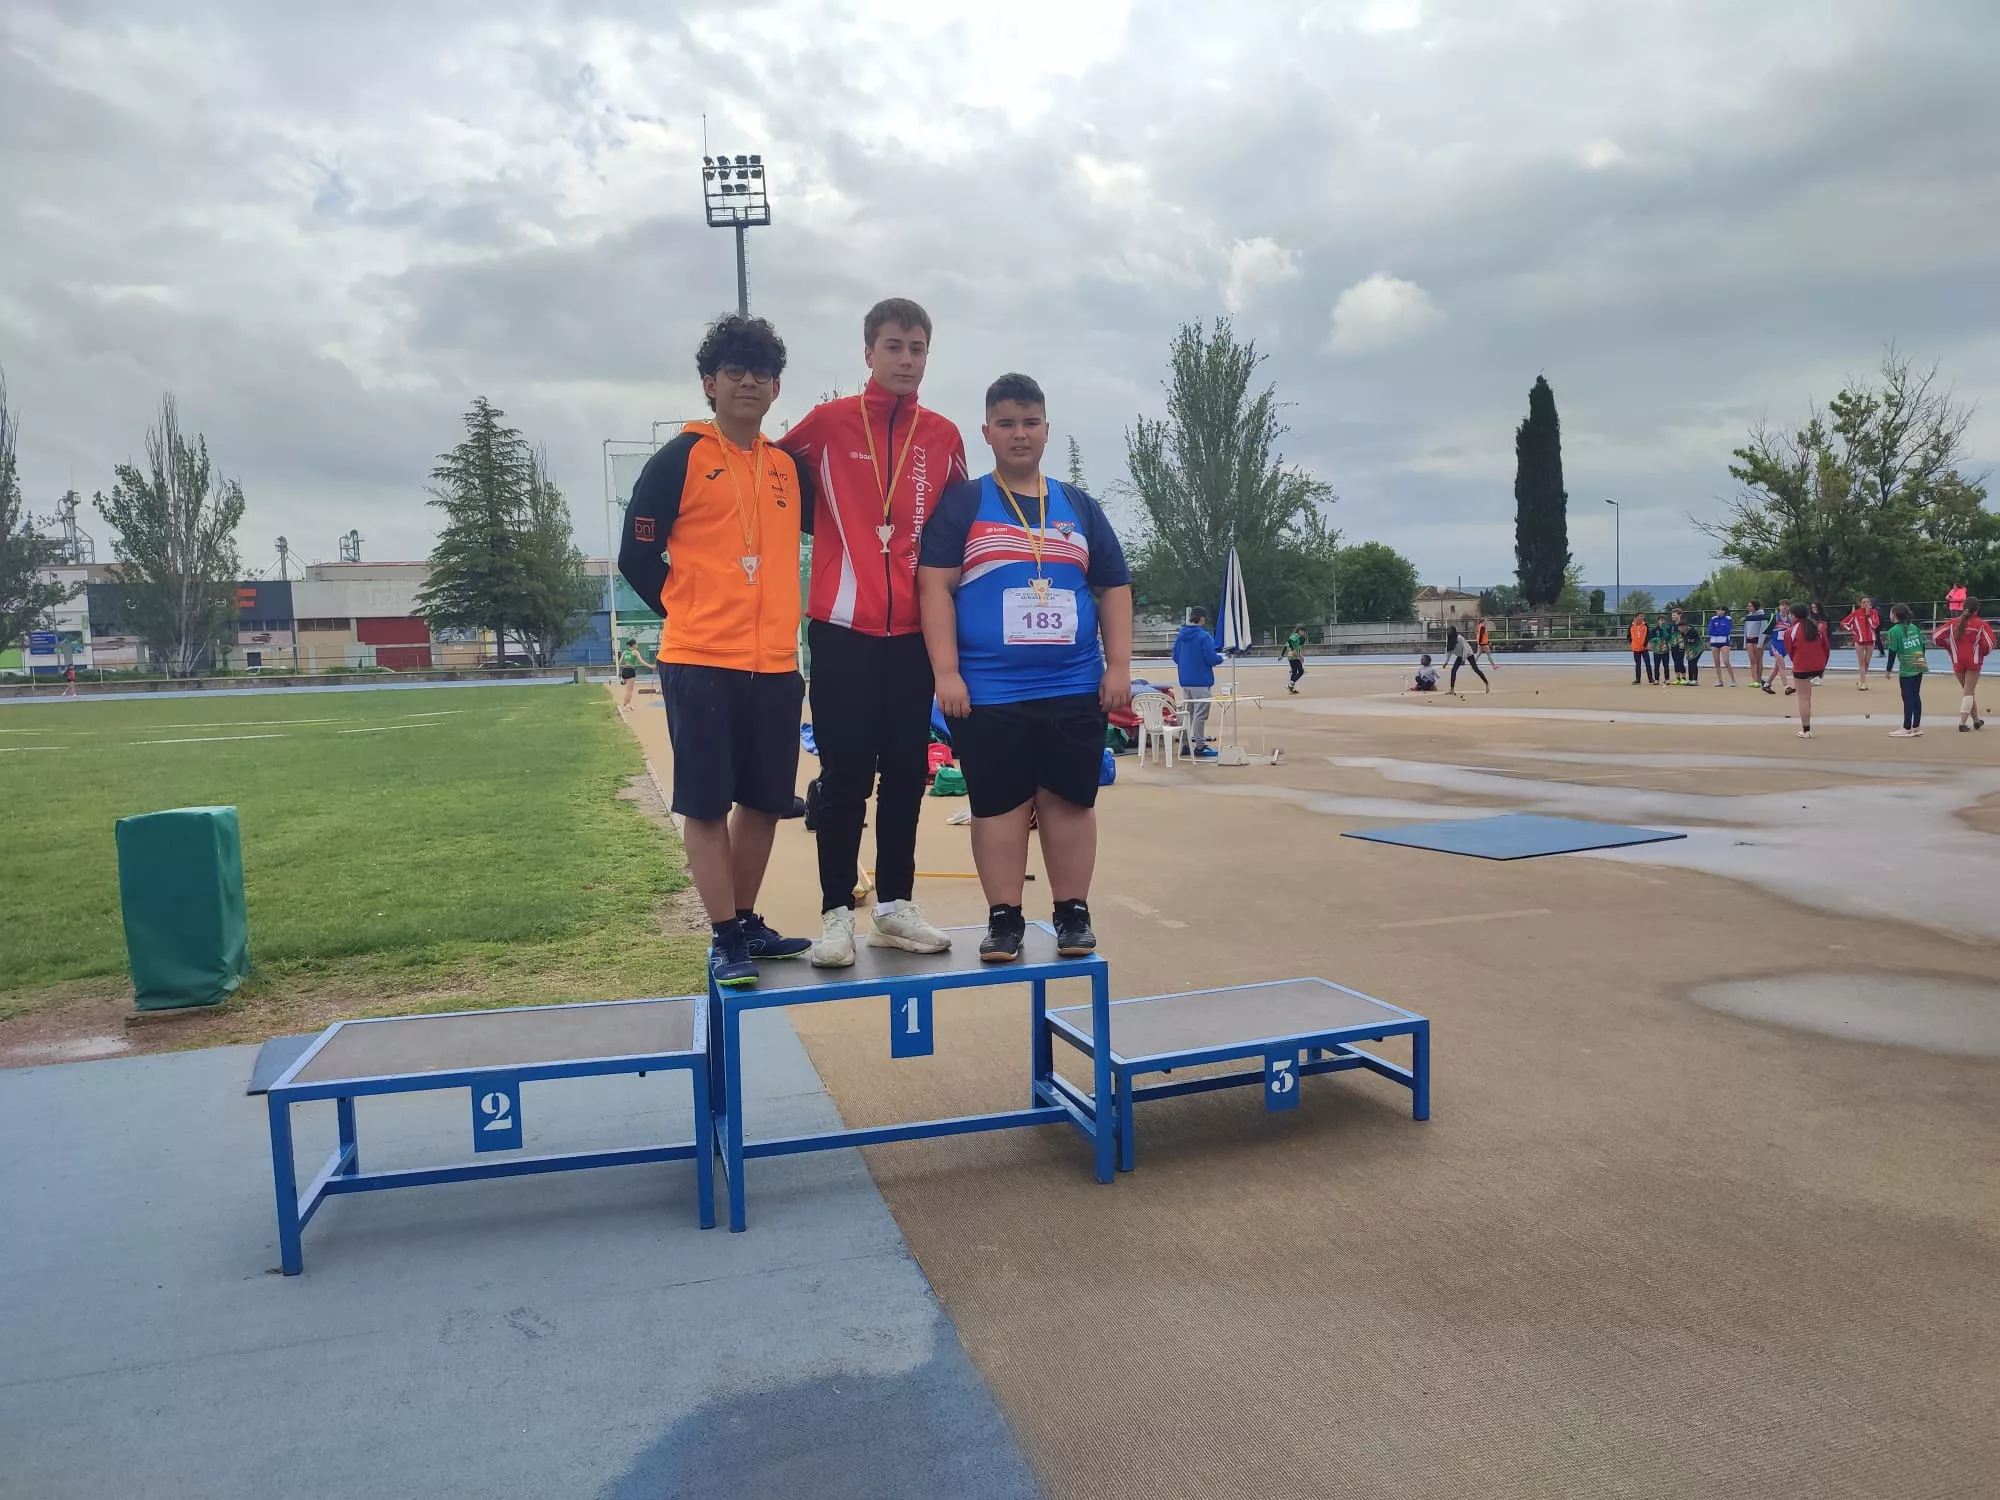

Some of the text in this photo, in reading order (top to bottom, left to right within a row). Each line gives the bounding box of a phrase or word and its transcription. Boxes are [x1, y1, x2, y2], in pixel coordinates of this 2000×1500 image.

[1022, 612, 1063, 630] 183
[901, 997, 920, 1034] 1
[1271, 1059, 1294, 1093] 3
[481, 1092, 513, 1131] 2
